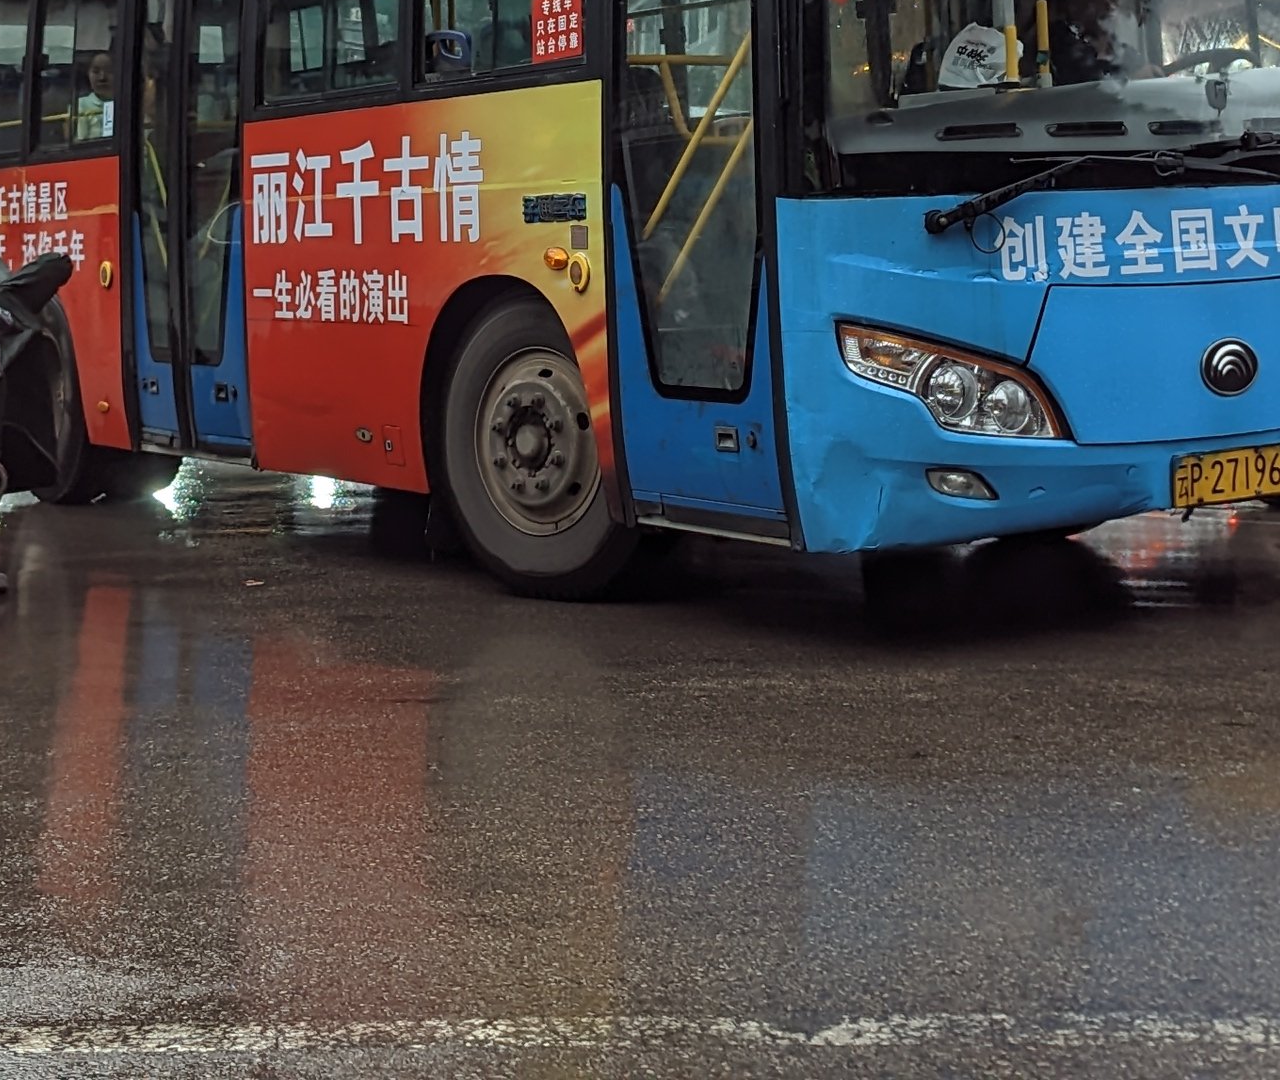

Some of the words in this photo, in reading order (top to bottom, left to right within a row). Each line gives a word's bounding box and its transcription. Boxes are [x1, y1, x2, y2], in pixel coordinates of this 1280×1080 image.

[536, 12, 579, 37] 只在固定
[536, 33, 579, 56] 站台停靠
[250, 130, 485, 246] 丽江千古情
[252, 267, 410, 325] 一生必看的演出
